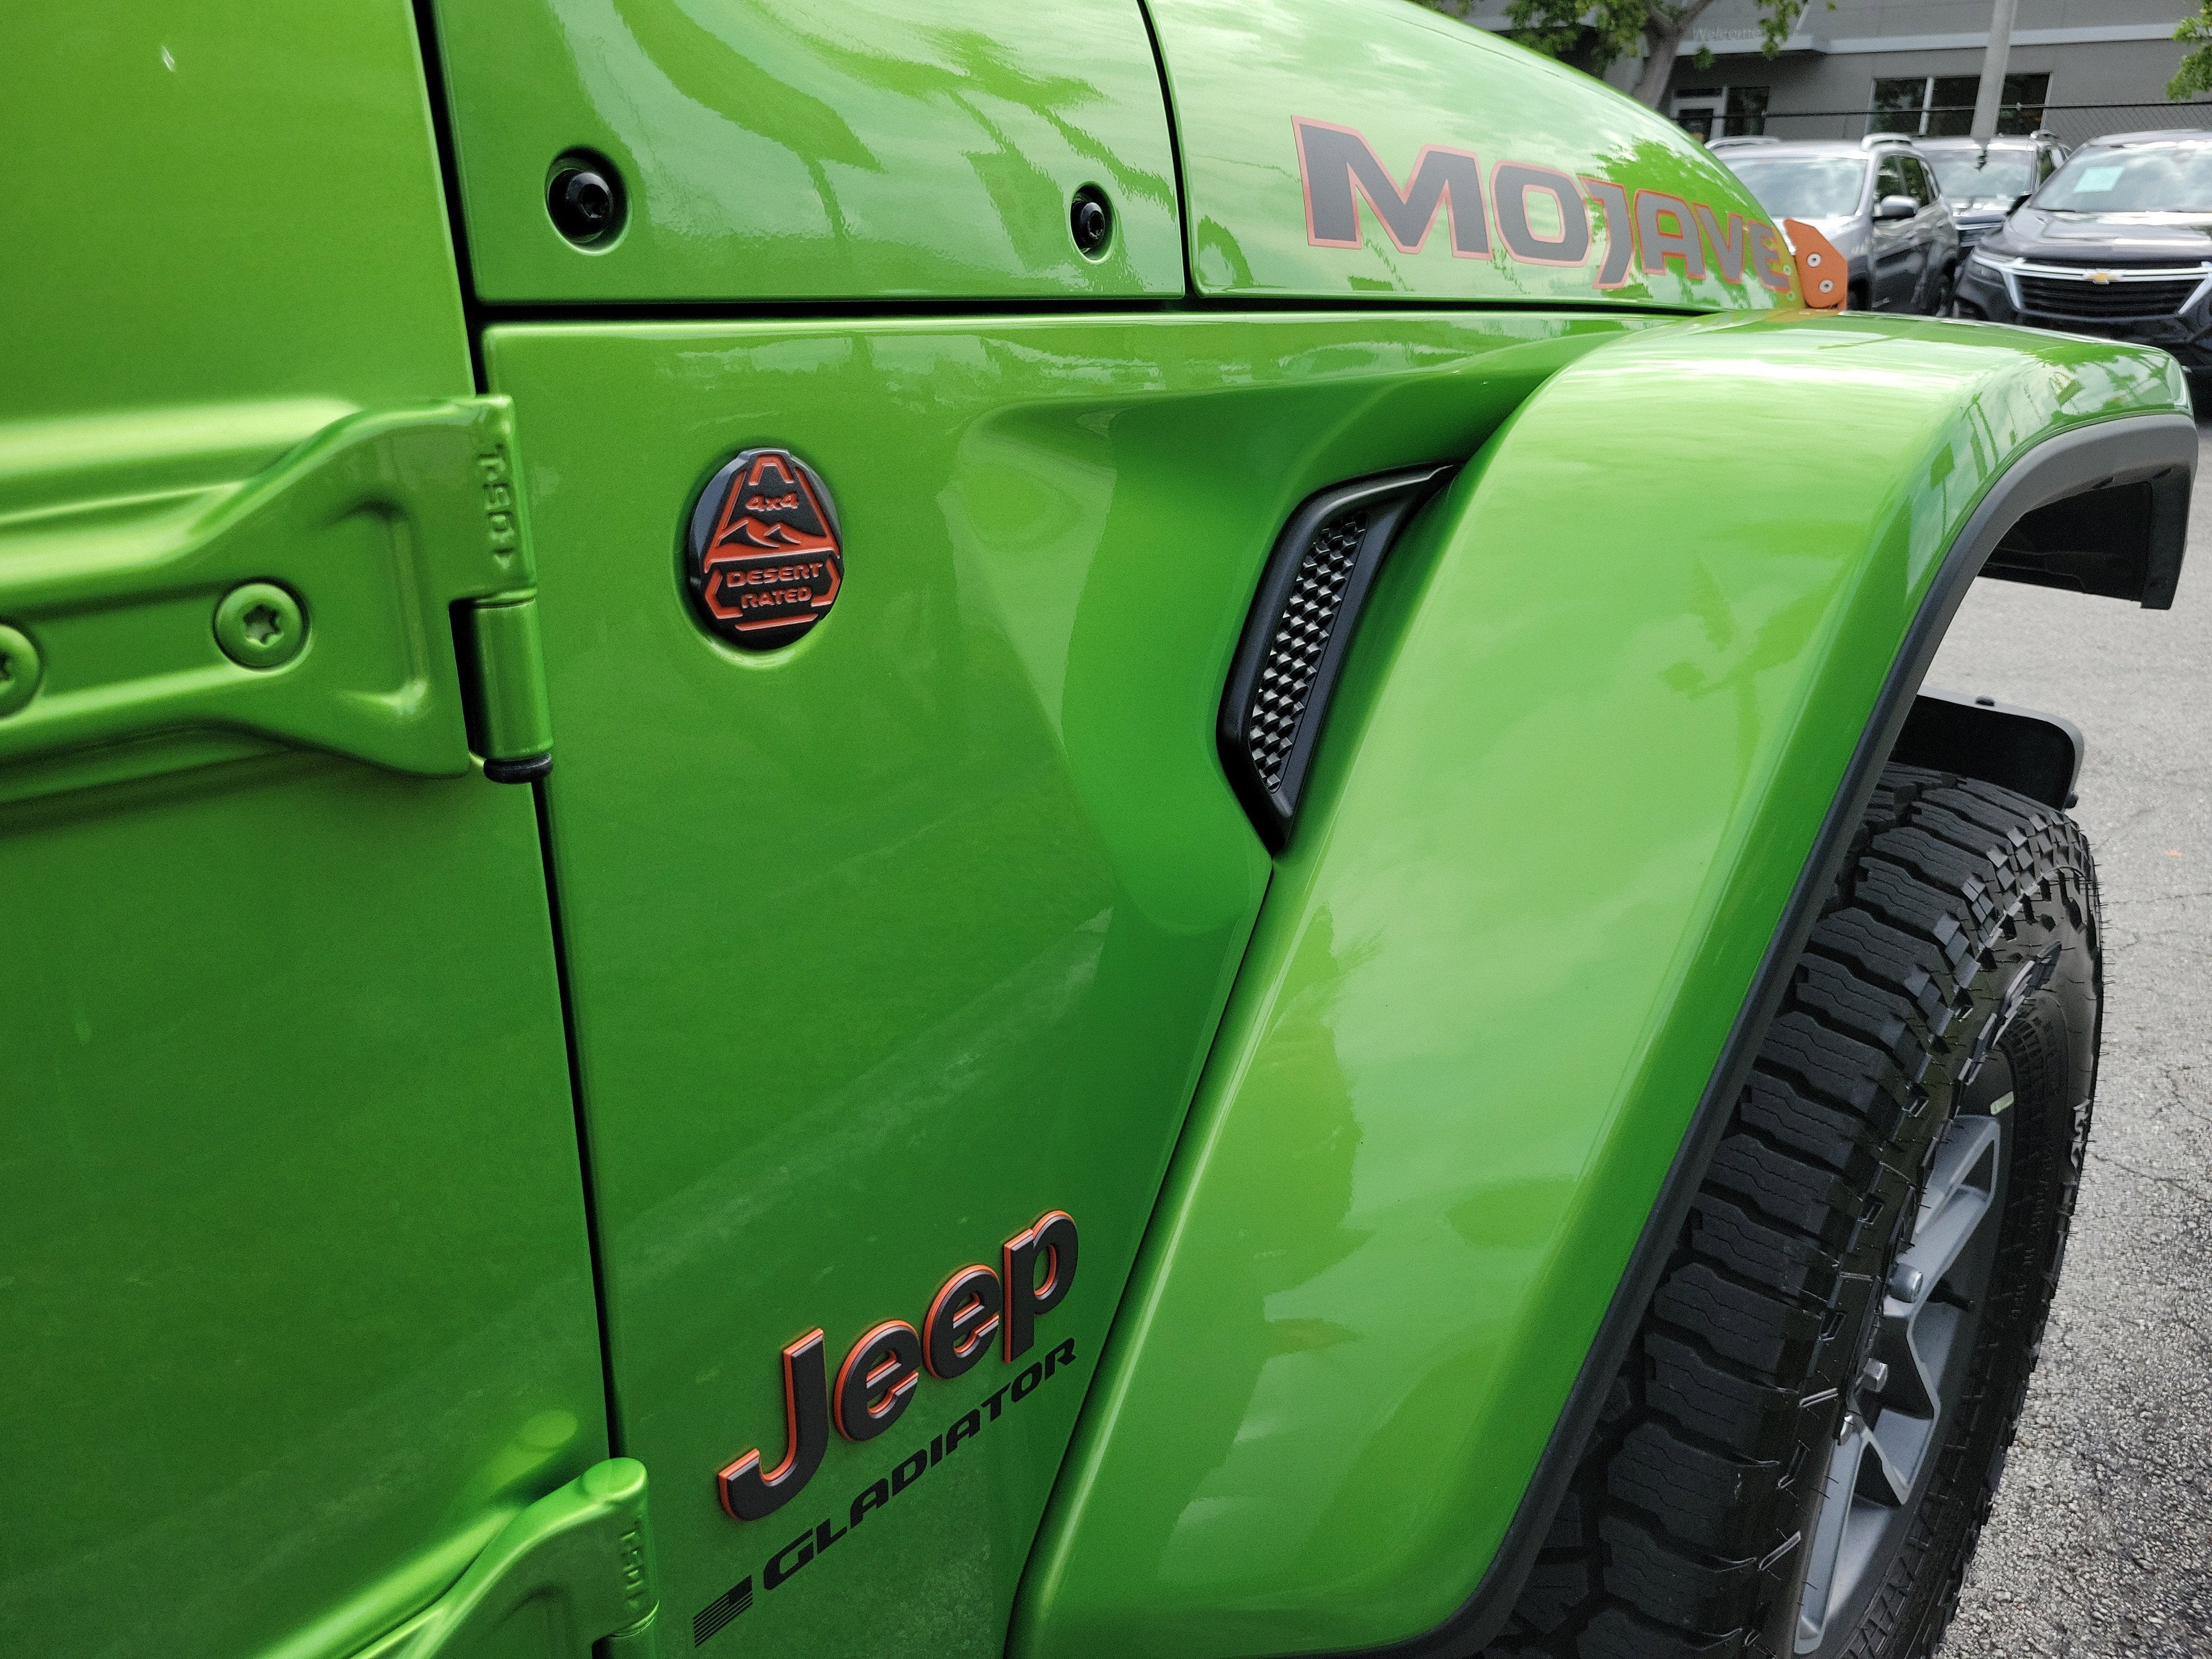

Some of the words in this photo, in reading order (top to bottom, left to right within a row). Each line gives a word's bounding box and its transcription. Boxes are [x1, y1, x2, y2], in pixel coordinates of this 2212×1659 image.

[1291, 115, 1791, 294] MOJAVE
[746, 492, 799, 511] 4x4
[726, 562, 823, 588] DESERT
[741, 586, 812, 608] RATED
[718, 1210, 1079, 1521] Jeep
[763, 1337, 1077, 1590] GLADIATOR
